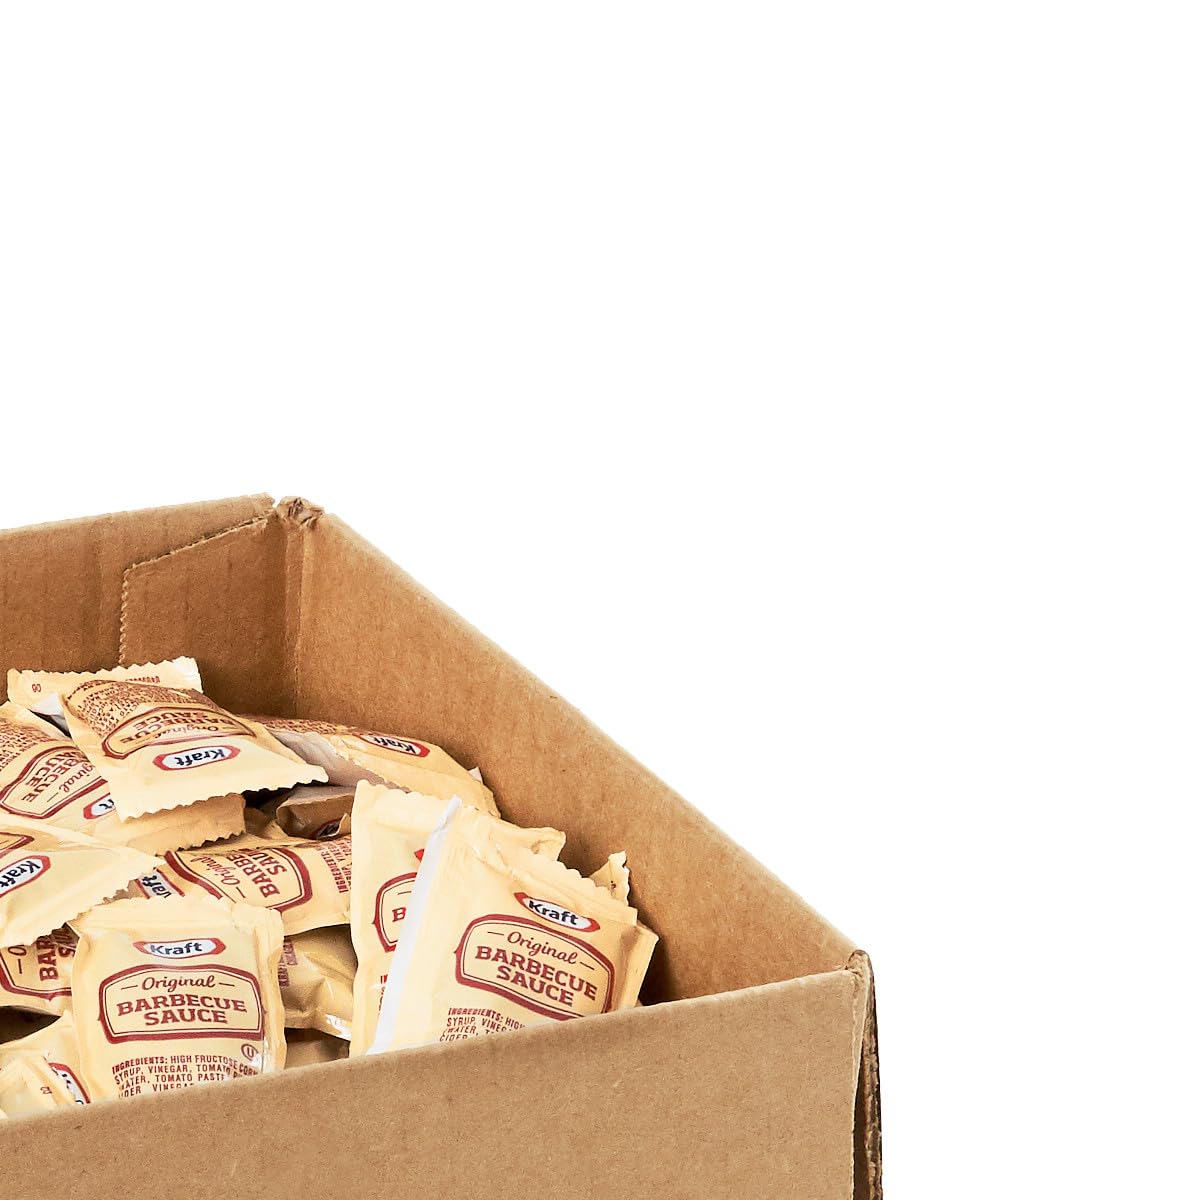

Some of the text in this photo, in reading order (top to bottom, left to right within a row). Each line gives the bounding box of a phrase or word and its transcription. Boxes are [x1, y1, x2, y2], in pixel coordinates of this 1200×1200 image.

[372, 736, 417, 754] Kraft
[174, 748, 226, 767] Kraft
[528, 899, 579, 926] Kraft
[150, 942, 203, 956] Kraft
[507, 931, 578, 965] Original
[474, 945, 598, 1001] BARBECUE
[141, 974, 216, 993] Original
[496, 965, 574, 1007] SAUCE
[116, 993, 248, 1017] BARBECUE
[143, 1008, 228, 1026] SAUCE
[112, 1056, 168, 1075] INGREDIENTS:
[170, 1055, 192, 1064] HIGH
[114, 1067, 144, 1085] SYRUP,
[147, 1064, 193, 1074] VINEGAR,
[155, 1073, 193, 1083] TOMATO
